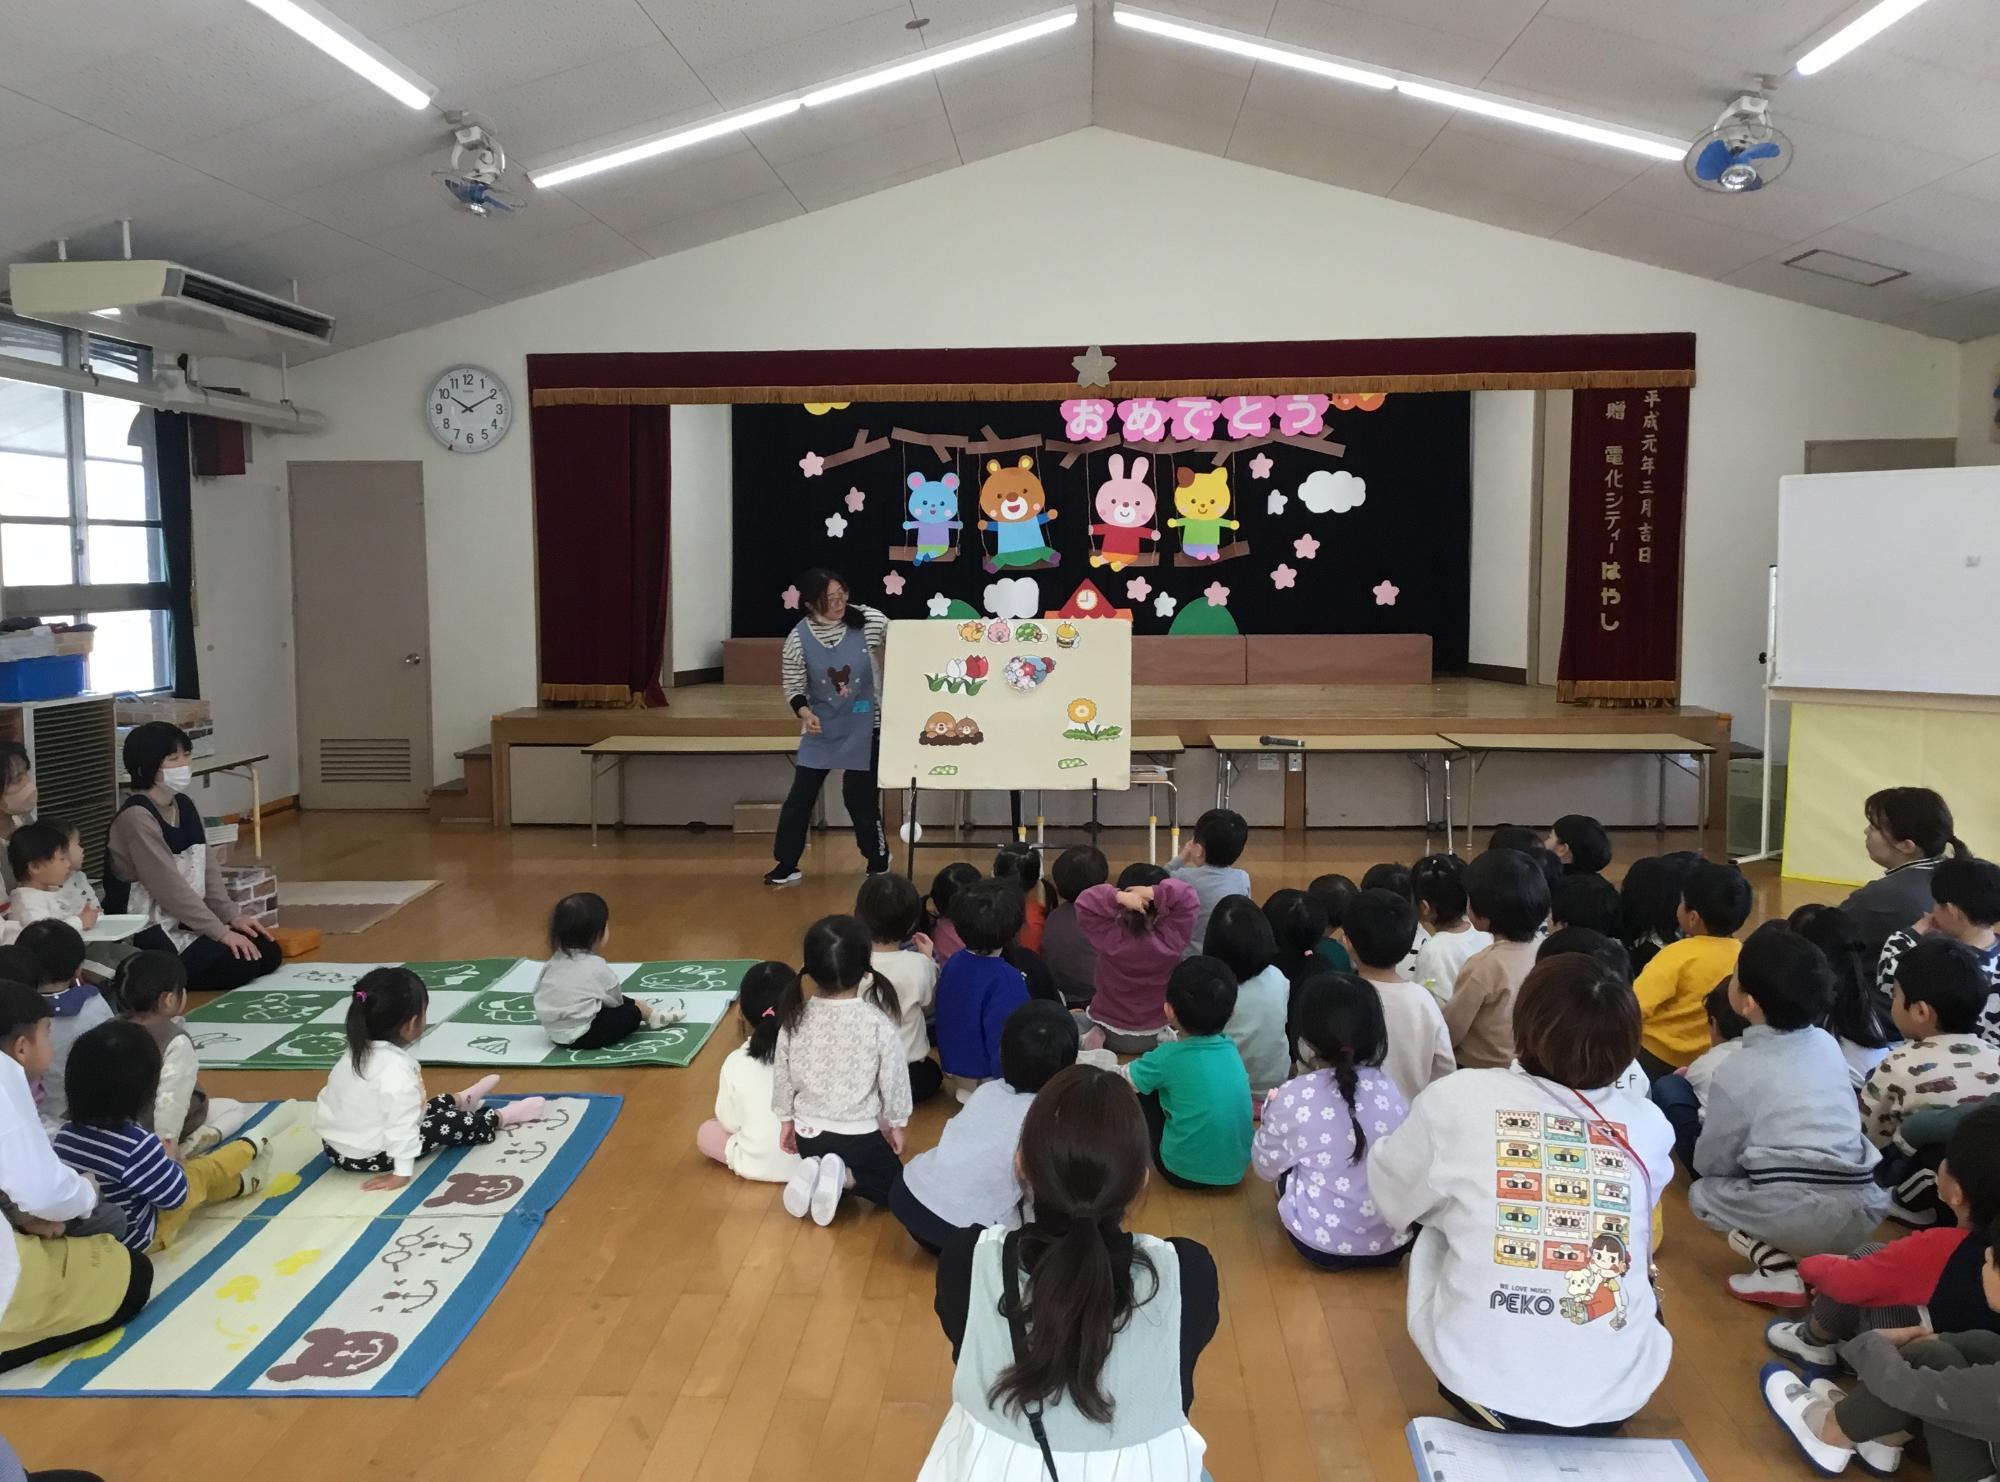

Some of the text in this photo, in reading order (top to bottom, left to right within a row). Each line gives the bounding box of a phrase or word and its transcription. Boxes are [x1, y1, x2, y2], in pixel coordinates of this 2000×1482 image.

[450, 378, 459, 389] 11
[462, 374, 474, 385] 12
[480, 379, 485, 389] 1
[439, 388, 450, 399] 10
[490, 388, 497, 399] 2
[435, 403, 443, 414] 9
[496, 404, 504, 415] 3
[1070, 395, 1316, 436] おめでとう
[443, 418, 450, 429] 8
[491, 418, 498, 429] 4
[454, 428, 461, 440] 7
[466, 432, 474, 444] 6
[481, 428, 489, 440] 5
[1638, 389, 1661, 563] 平成元年三月吉日
[1489, 1290, 1555, 1316] PEKO
